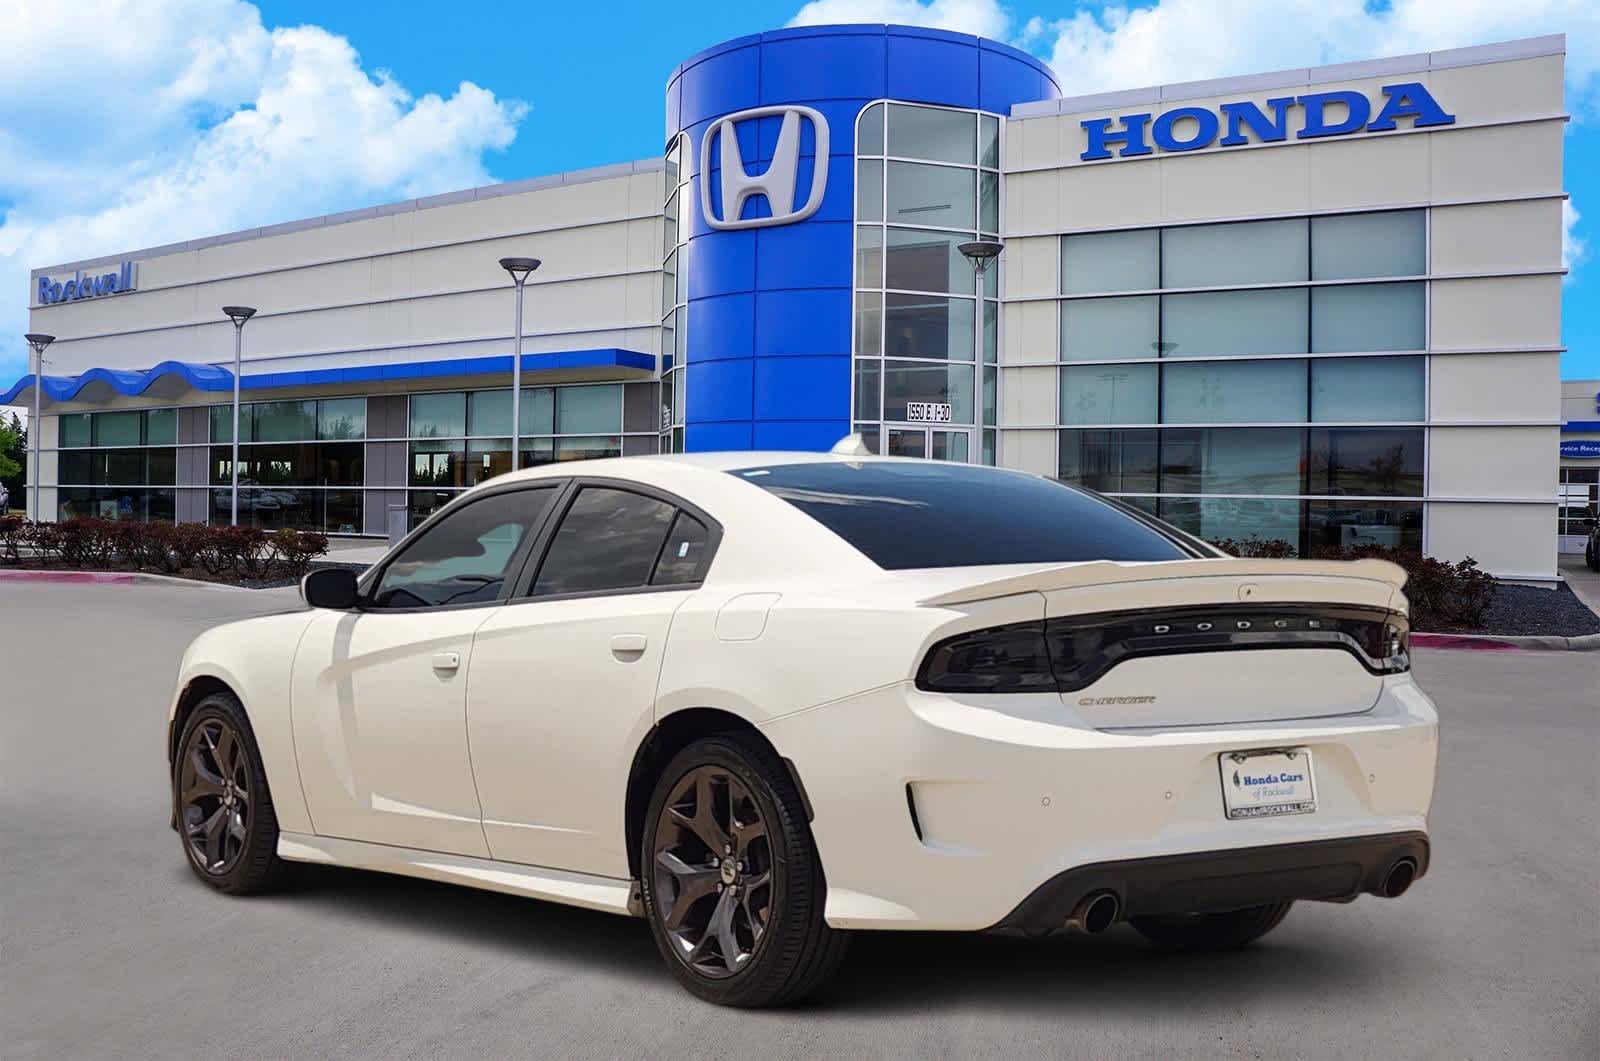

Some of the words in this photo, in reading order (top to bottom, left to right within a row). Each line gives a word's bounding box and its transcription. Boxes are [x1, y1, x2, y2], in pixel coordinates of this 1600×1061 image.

[1080, 82, 1456, 161] HONDA
[38, 261, 132, 304] Rockwall
[909, 404, 925, 420] 1550
[1154, 619, 1320, 634] DODGE
[1243, 774, 1279, 786] Honda
[1280, 772, 1304, 783] Cars
